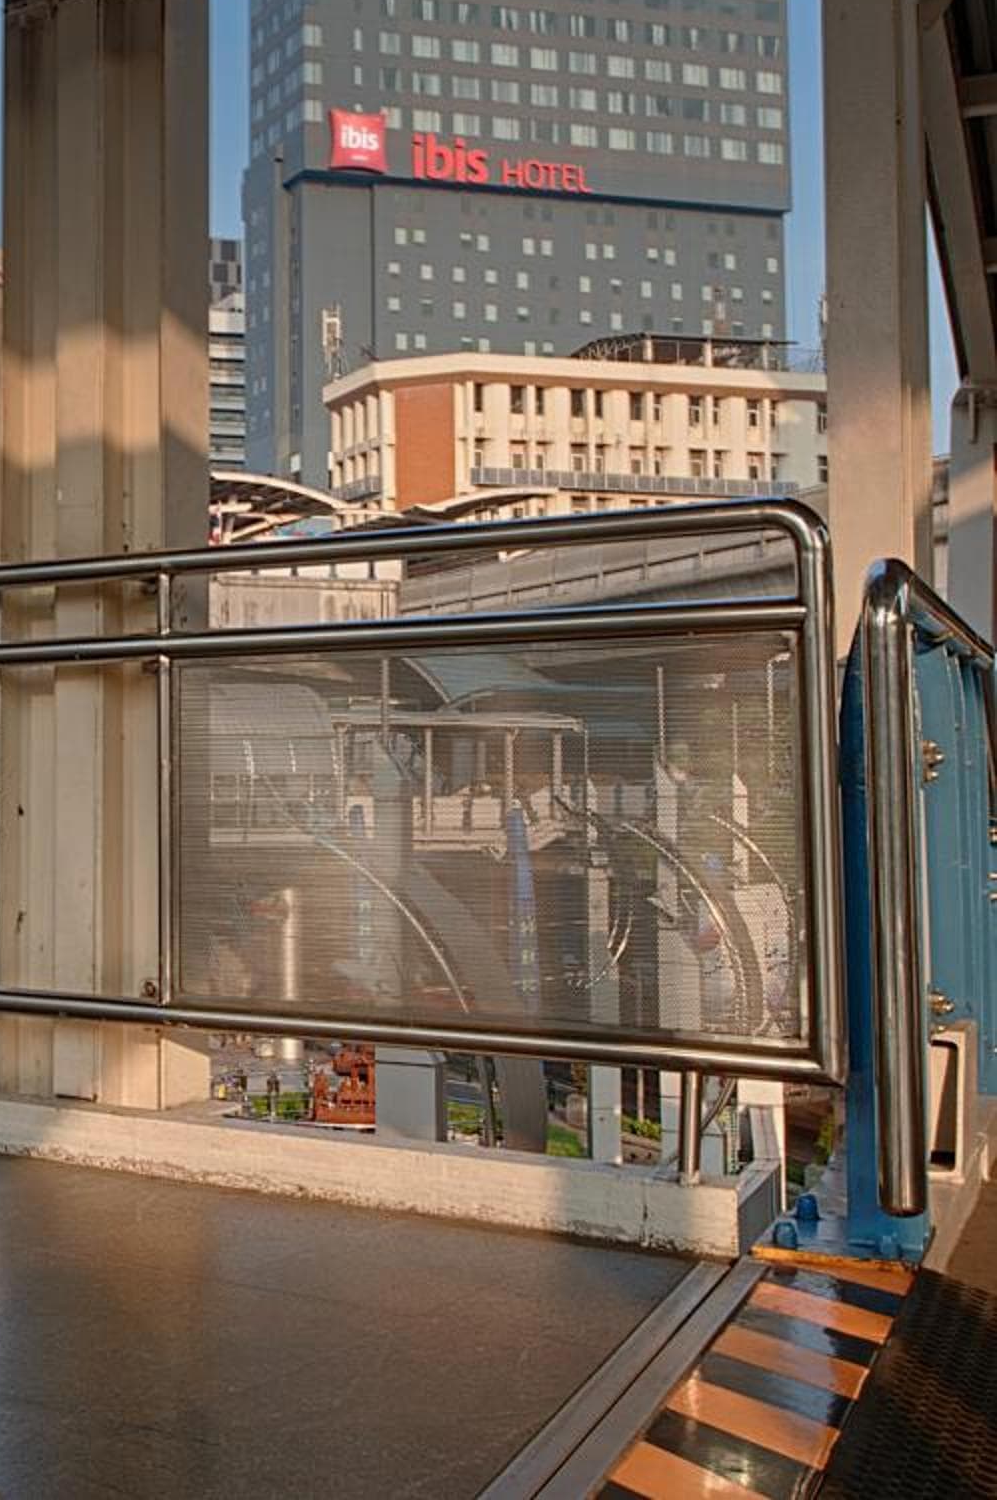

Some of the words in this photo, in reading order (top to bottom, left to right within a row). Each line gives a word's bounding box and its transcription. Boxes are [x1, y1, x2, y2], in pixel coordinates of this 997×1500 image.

[340, 123, 380, 151] ibis
[412, 132, 490, 185] ibis
[502, 156, 594, 193] HOTEL
